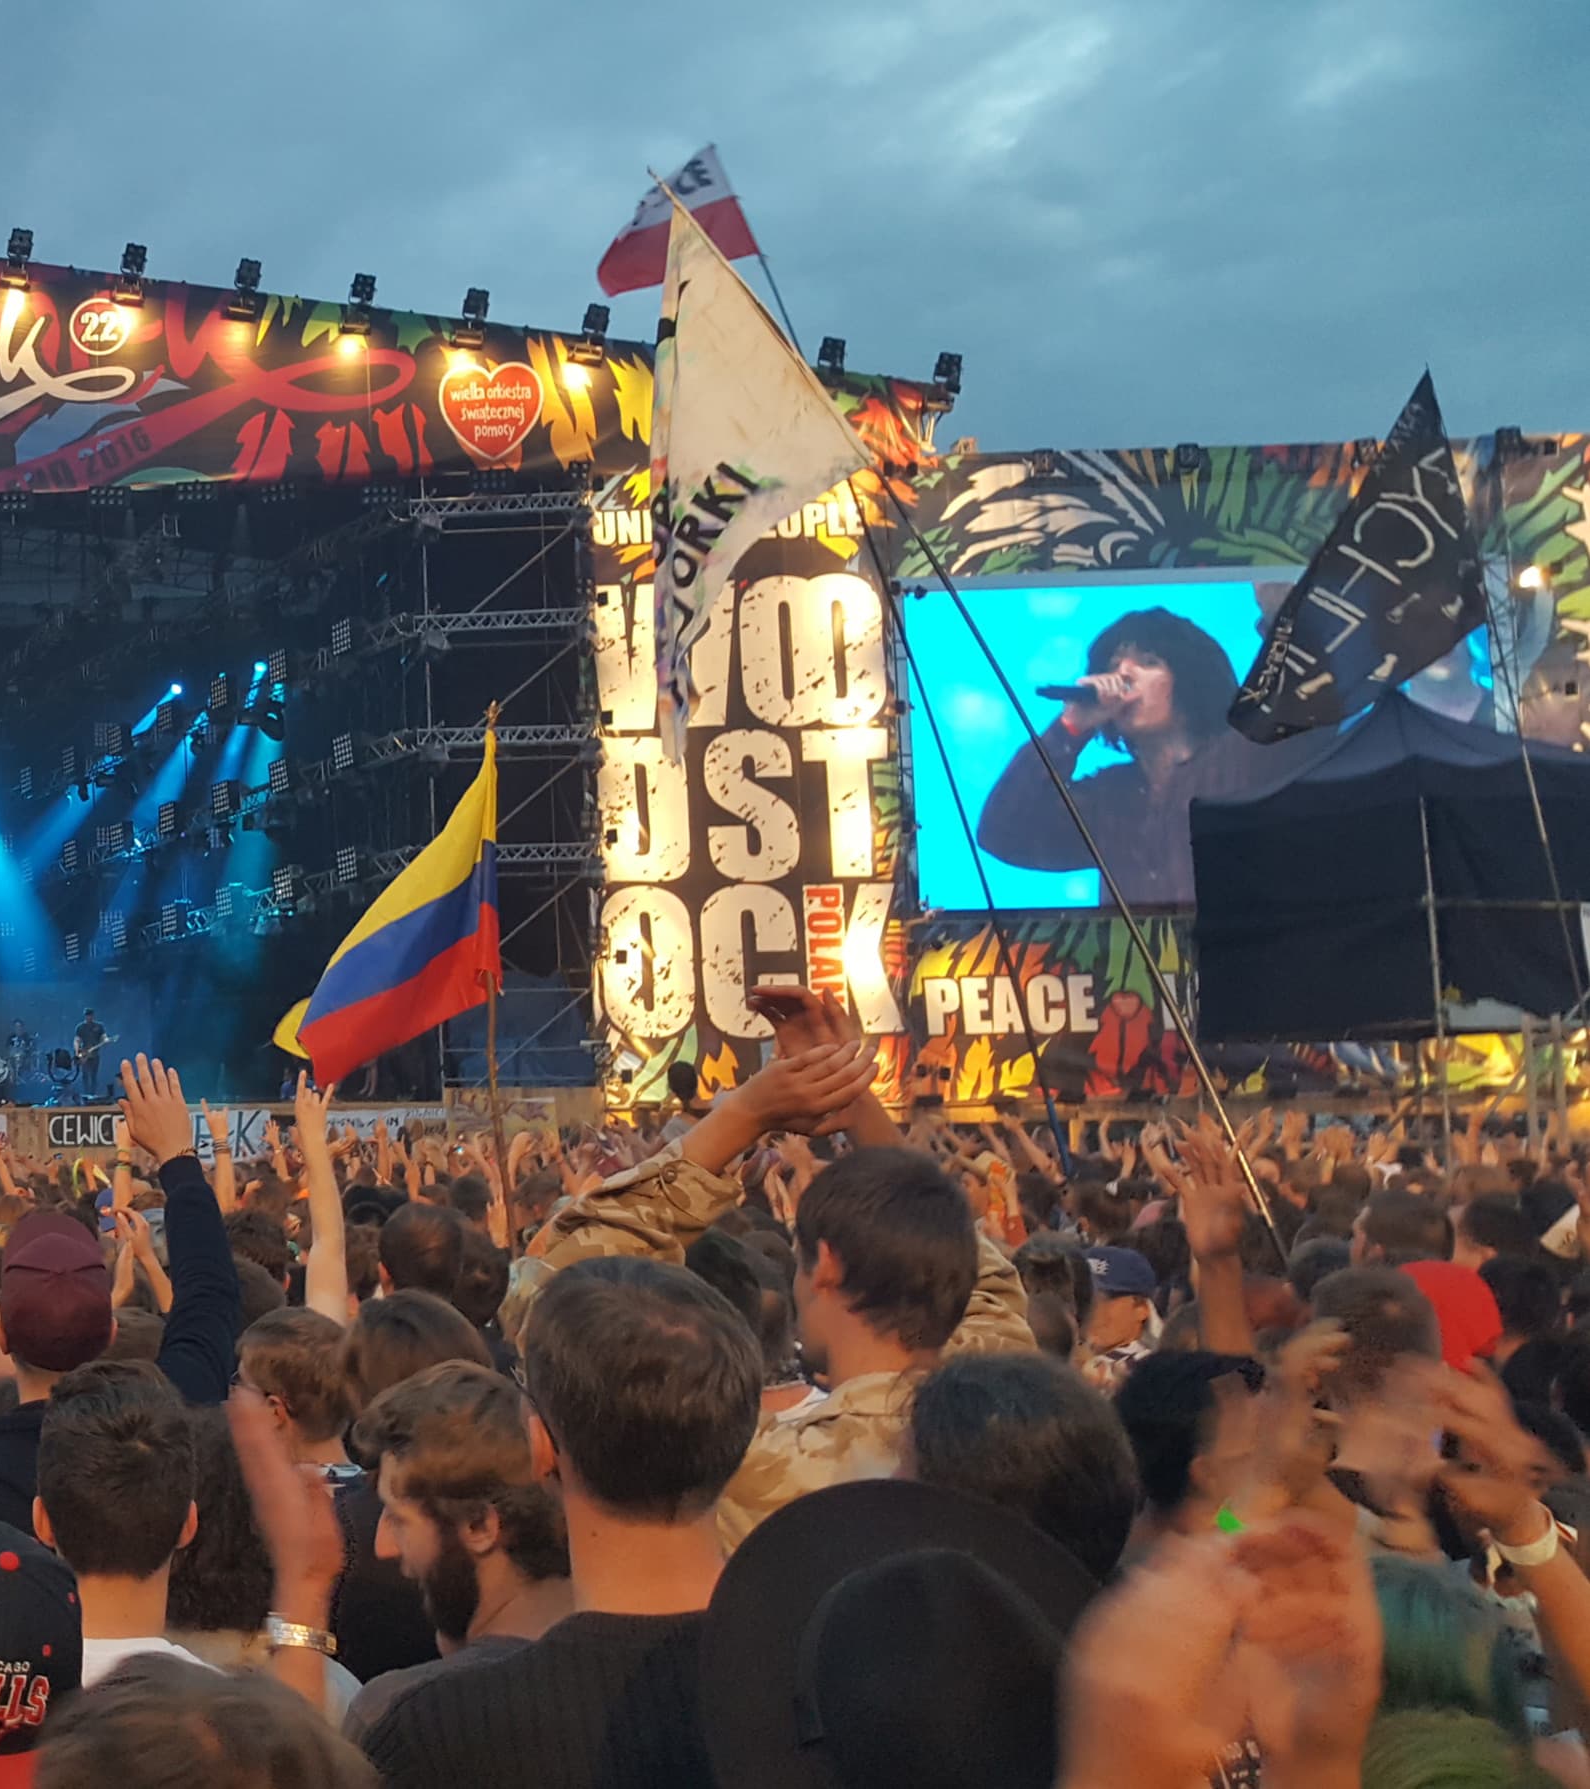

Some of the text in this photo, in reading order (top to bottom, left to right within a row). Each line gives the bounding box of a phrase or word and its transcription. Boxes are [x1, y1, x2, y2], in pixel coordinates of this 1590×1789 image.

[80, 311, 119, 343] 22
[450, 382, 532, 401] wielka orkiestra
[460, 402, 525, 425] świątecznej
[474, 424, 516, 442] pomocy
[924, 974, 1099, 1036] PEACE
